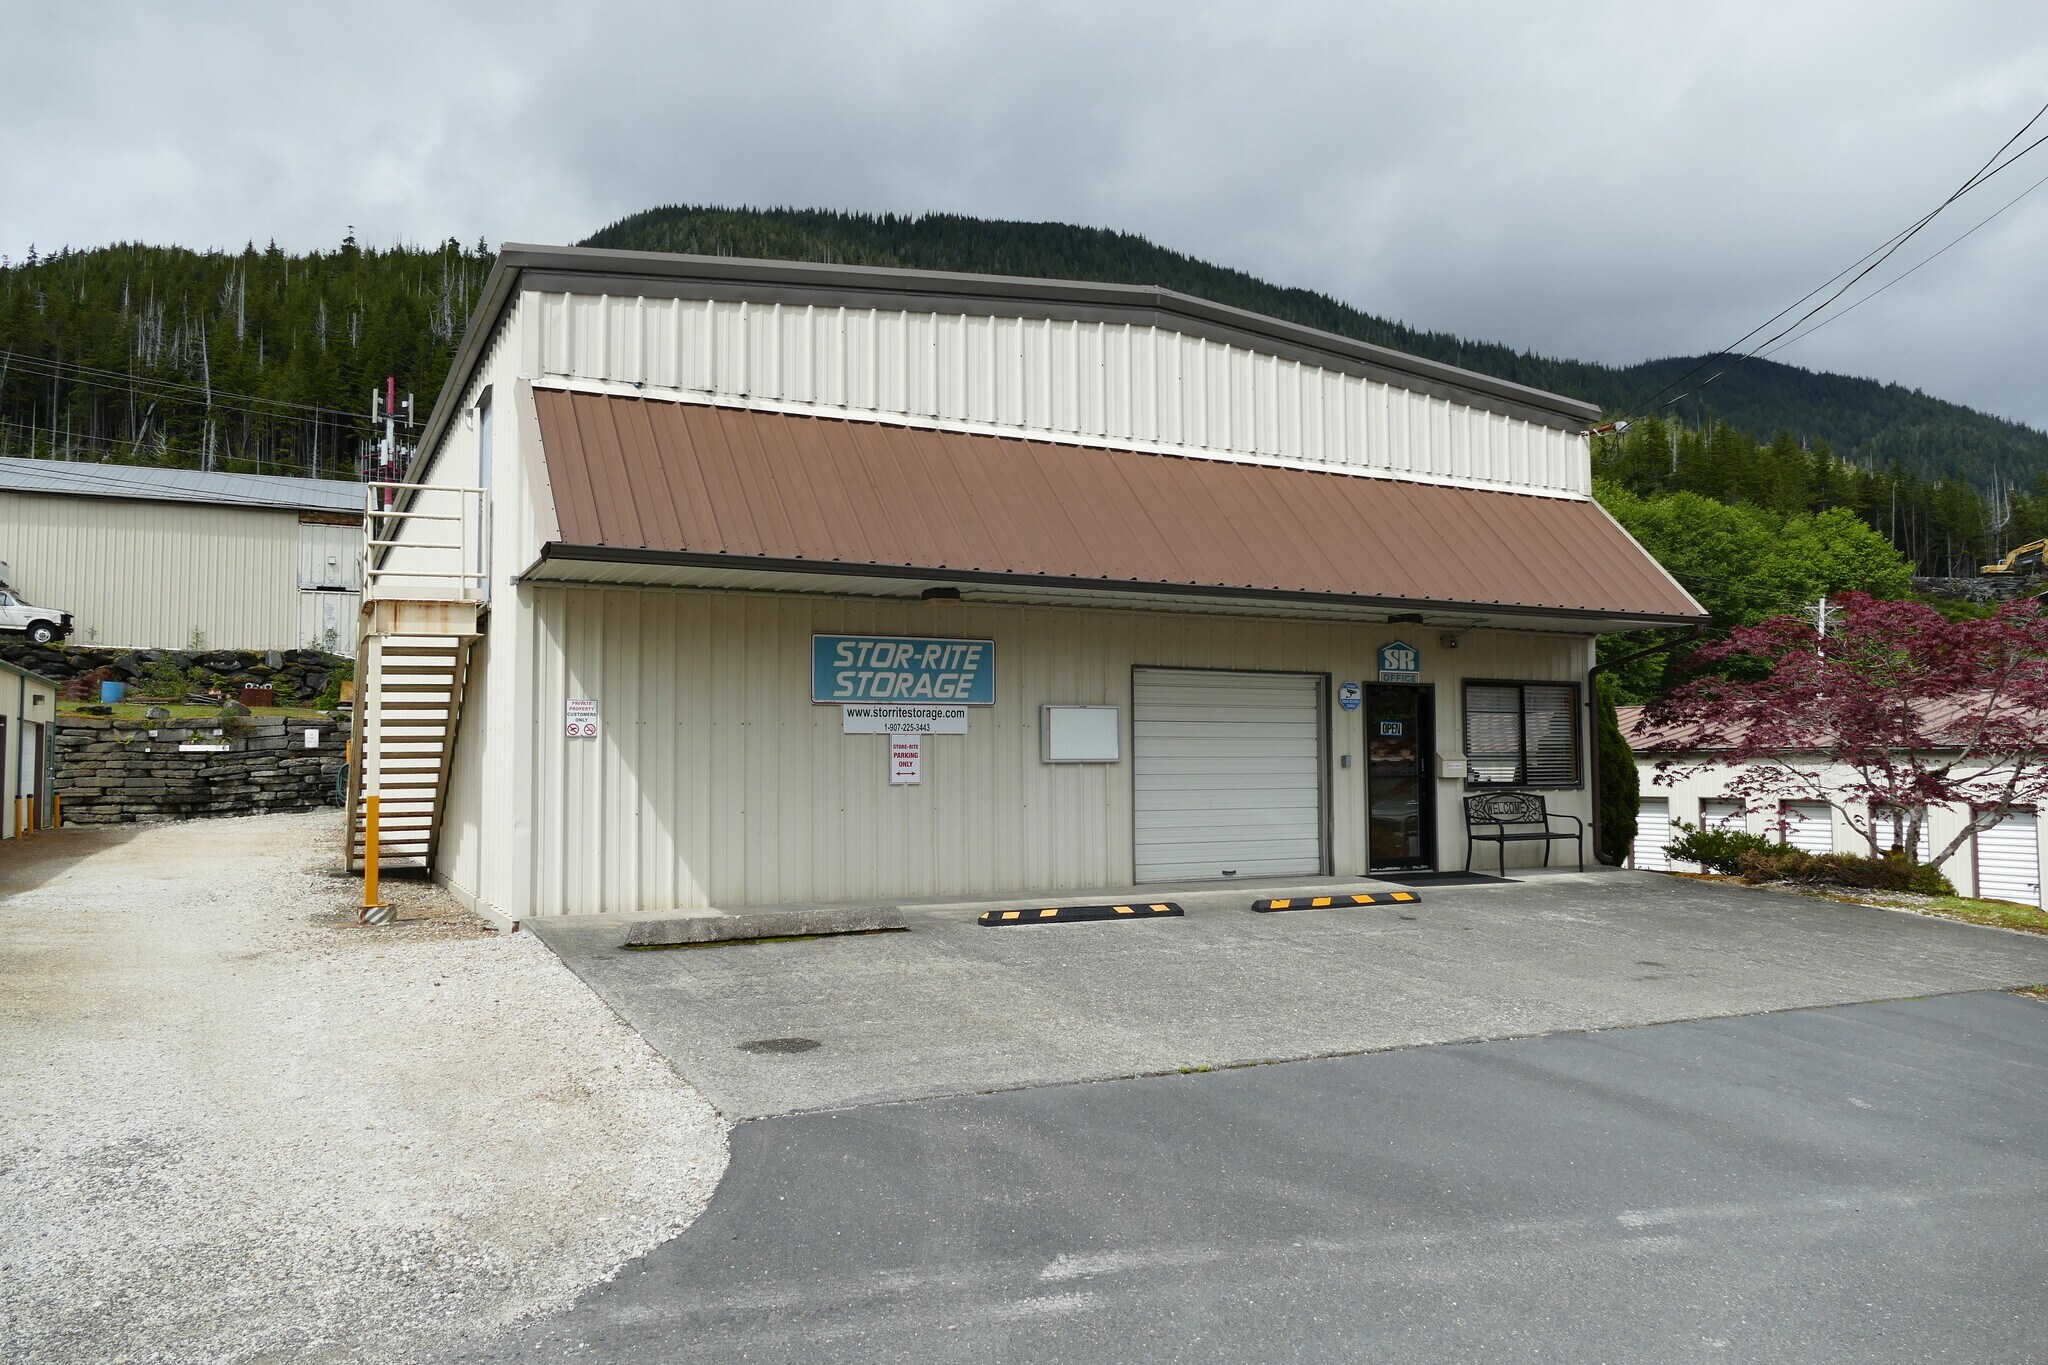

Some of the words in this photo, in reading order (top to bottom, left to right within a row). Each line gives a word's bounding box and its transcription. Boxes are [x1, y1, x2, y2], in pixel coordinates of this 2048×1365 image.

[833, 641, 983, 670] STOR-RITE
[1384, 649, 1415, 670] SR
[833, 671, 975, 698] STORAGE
[1383, 674, 1417, 683] OFFICE
[846, 707, 965, 720] www.storritestorage.com
[884, 723, 931, 732] 1-907-225-3443
[1382, 723, 1401, 735] OPEN
[898, 760, 914, 768] ONLY
[1485, 801, 1527, 814] WELCOME
